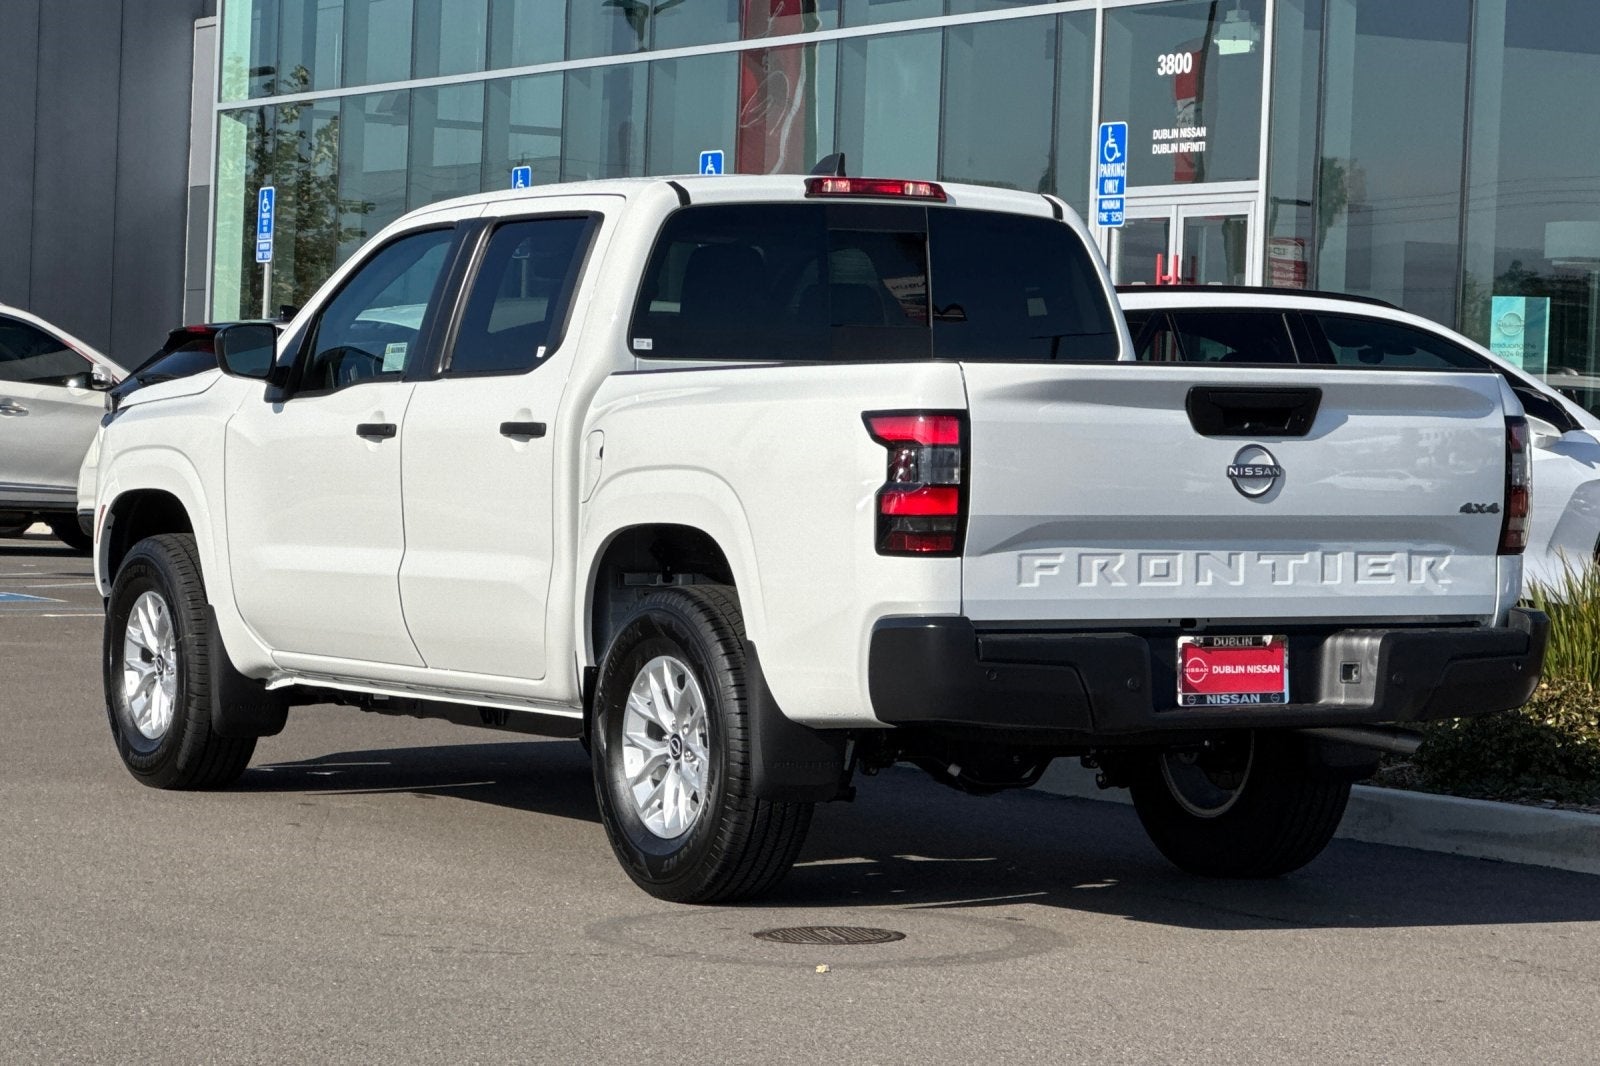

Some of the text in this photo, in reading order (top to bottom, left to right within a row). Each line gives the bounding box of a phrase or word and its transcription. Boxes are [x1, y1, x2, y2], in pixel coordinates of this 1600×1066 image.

[1157, 52, 1192, 75] 3800
[1153, 127, 1206, 140] DUBLIN NISSAN
[1152, 142, 1206, 154] DUBLIN INFINITI
[1100, 162, 1124, 177] PARKING
[1104, 179, 1119, 193] ONLY
[1228, 466, 1280, 476] NISSAN
[1017, 550, 1455, 588] FRONTIER
[1213, 637, 1253, 647] DUBLIN
[1212, 664, 1280, 674] DUBLIN NISSAN
[1206, 694, 1260, 704] NISSAN
